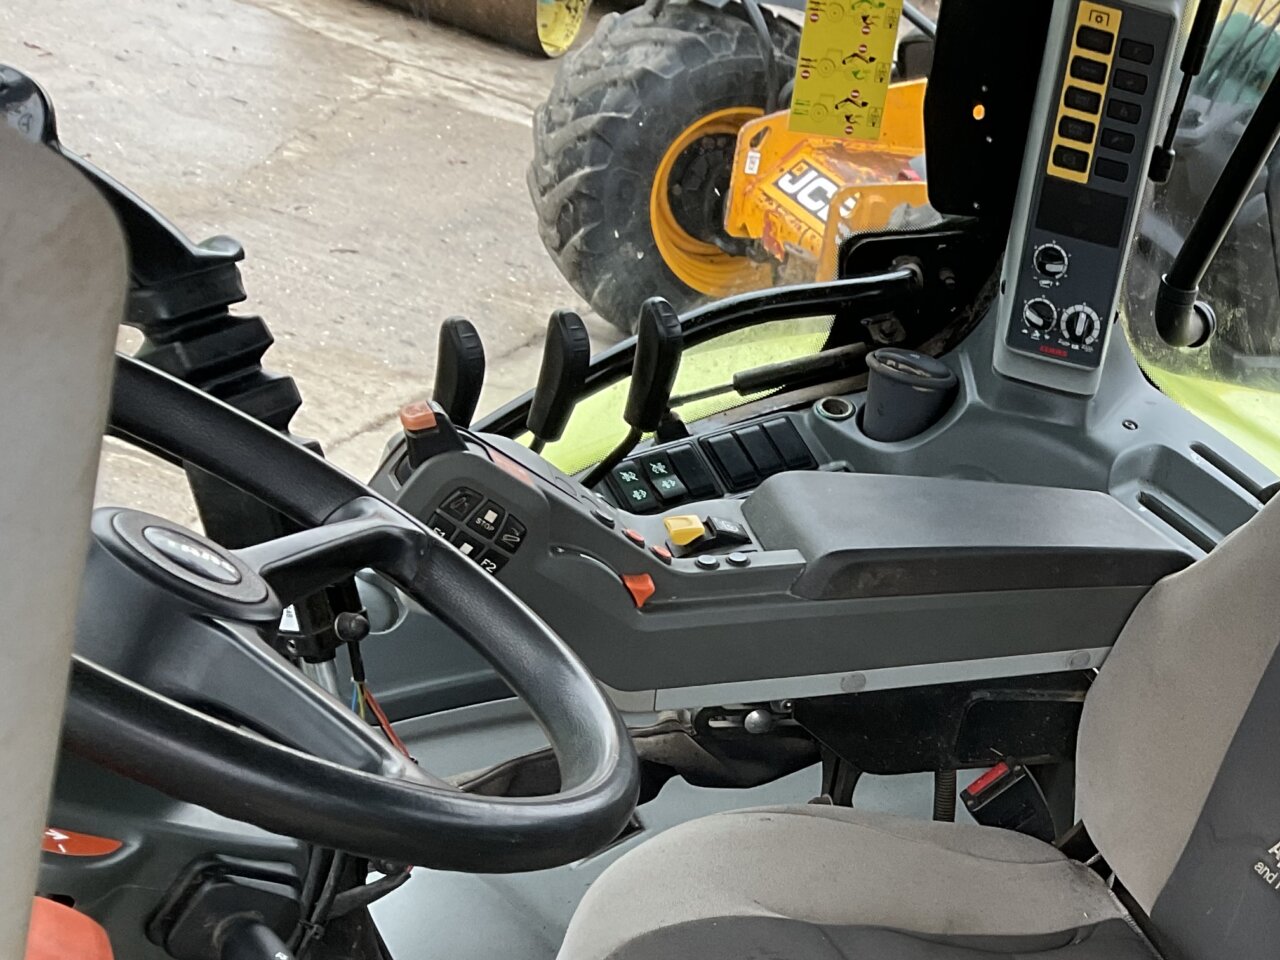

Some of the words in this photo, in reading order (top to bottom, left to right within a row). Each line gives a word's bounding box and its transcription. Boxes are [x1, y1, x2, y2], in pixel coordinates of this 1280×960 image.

[475, 517, 495, 531] STOP
[480, 558, 497, 573] F2
[1254, 861, 1279, 884] and
